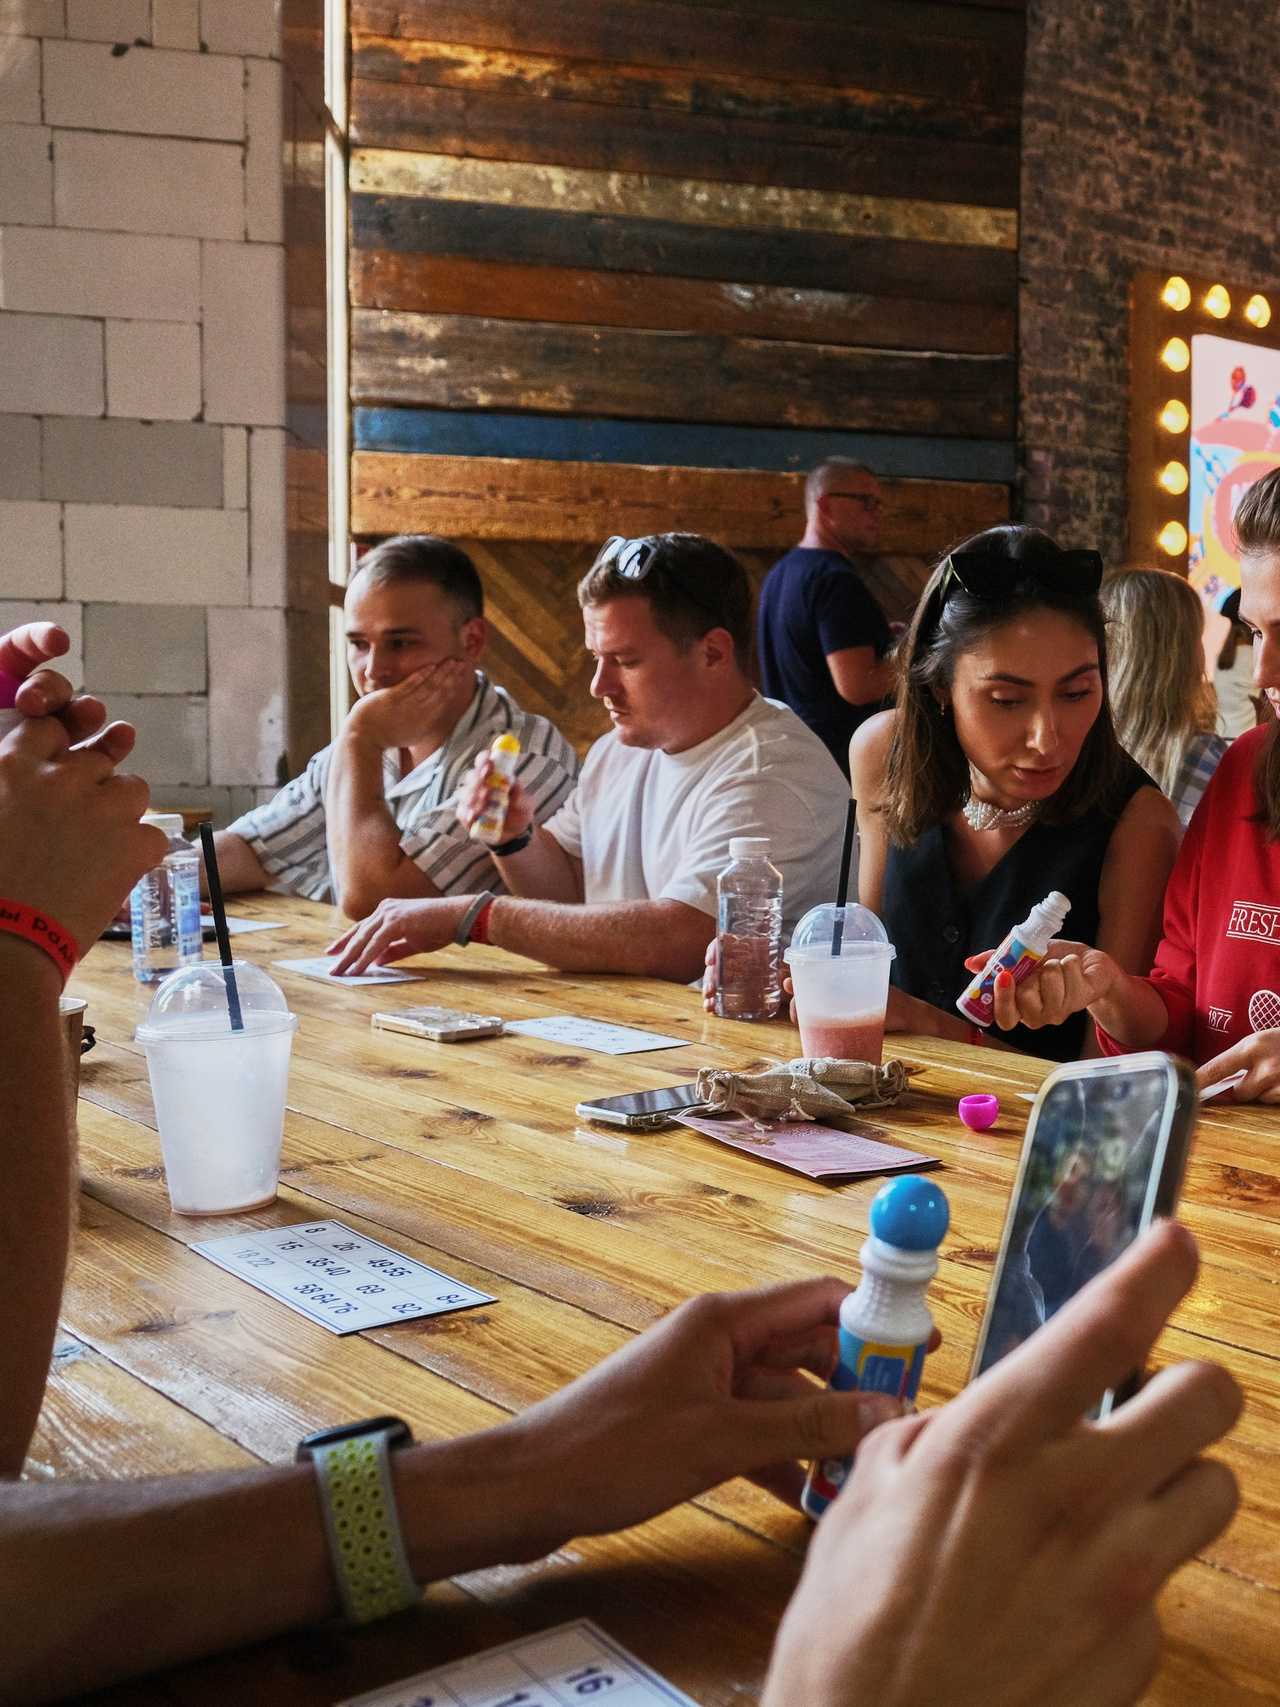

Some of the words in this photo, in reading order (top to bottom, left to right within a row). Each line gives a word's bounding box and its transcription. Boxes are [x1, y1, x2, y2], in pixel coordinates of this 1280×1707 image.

[1208, 1009, 1232, 1030] 1877
[233, 1249, 260, 1259] 18
[246, 1257, 276, 1268] 22
[276, 1241, 304, 1251] 15
[306, 1257, 335, 1268] 35
[323, 1266, 351, 1276] 40
[355, 1284, 386, 1295] 69
[391, 1302, 423, 1314] 82
[331, 1241, 362, 1252] 26
[367, 1259, 395, 1268] 49
[382, 1266, 412, 1277] 55
[436, 1294, 467, 1304] 84
[293, 1283, 324, 1295] 58
[310, 1293, 341, 1304] 64
[327, 1302, 359, 1315] 76
[565, 1667, 615, 1694] 16
